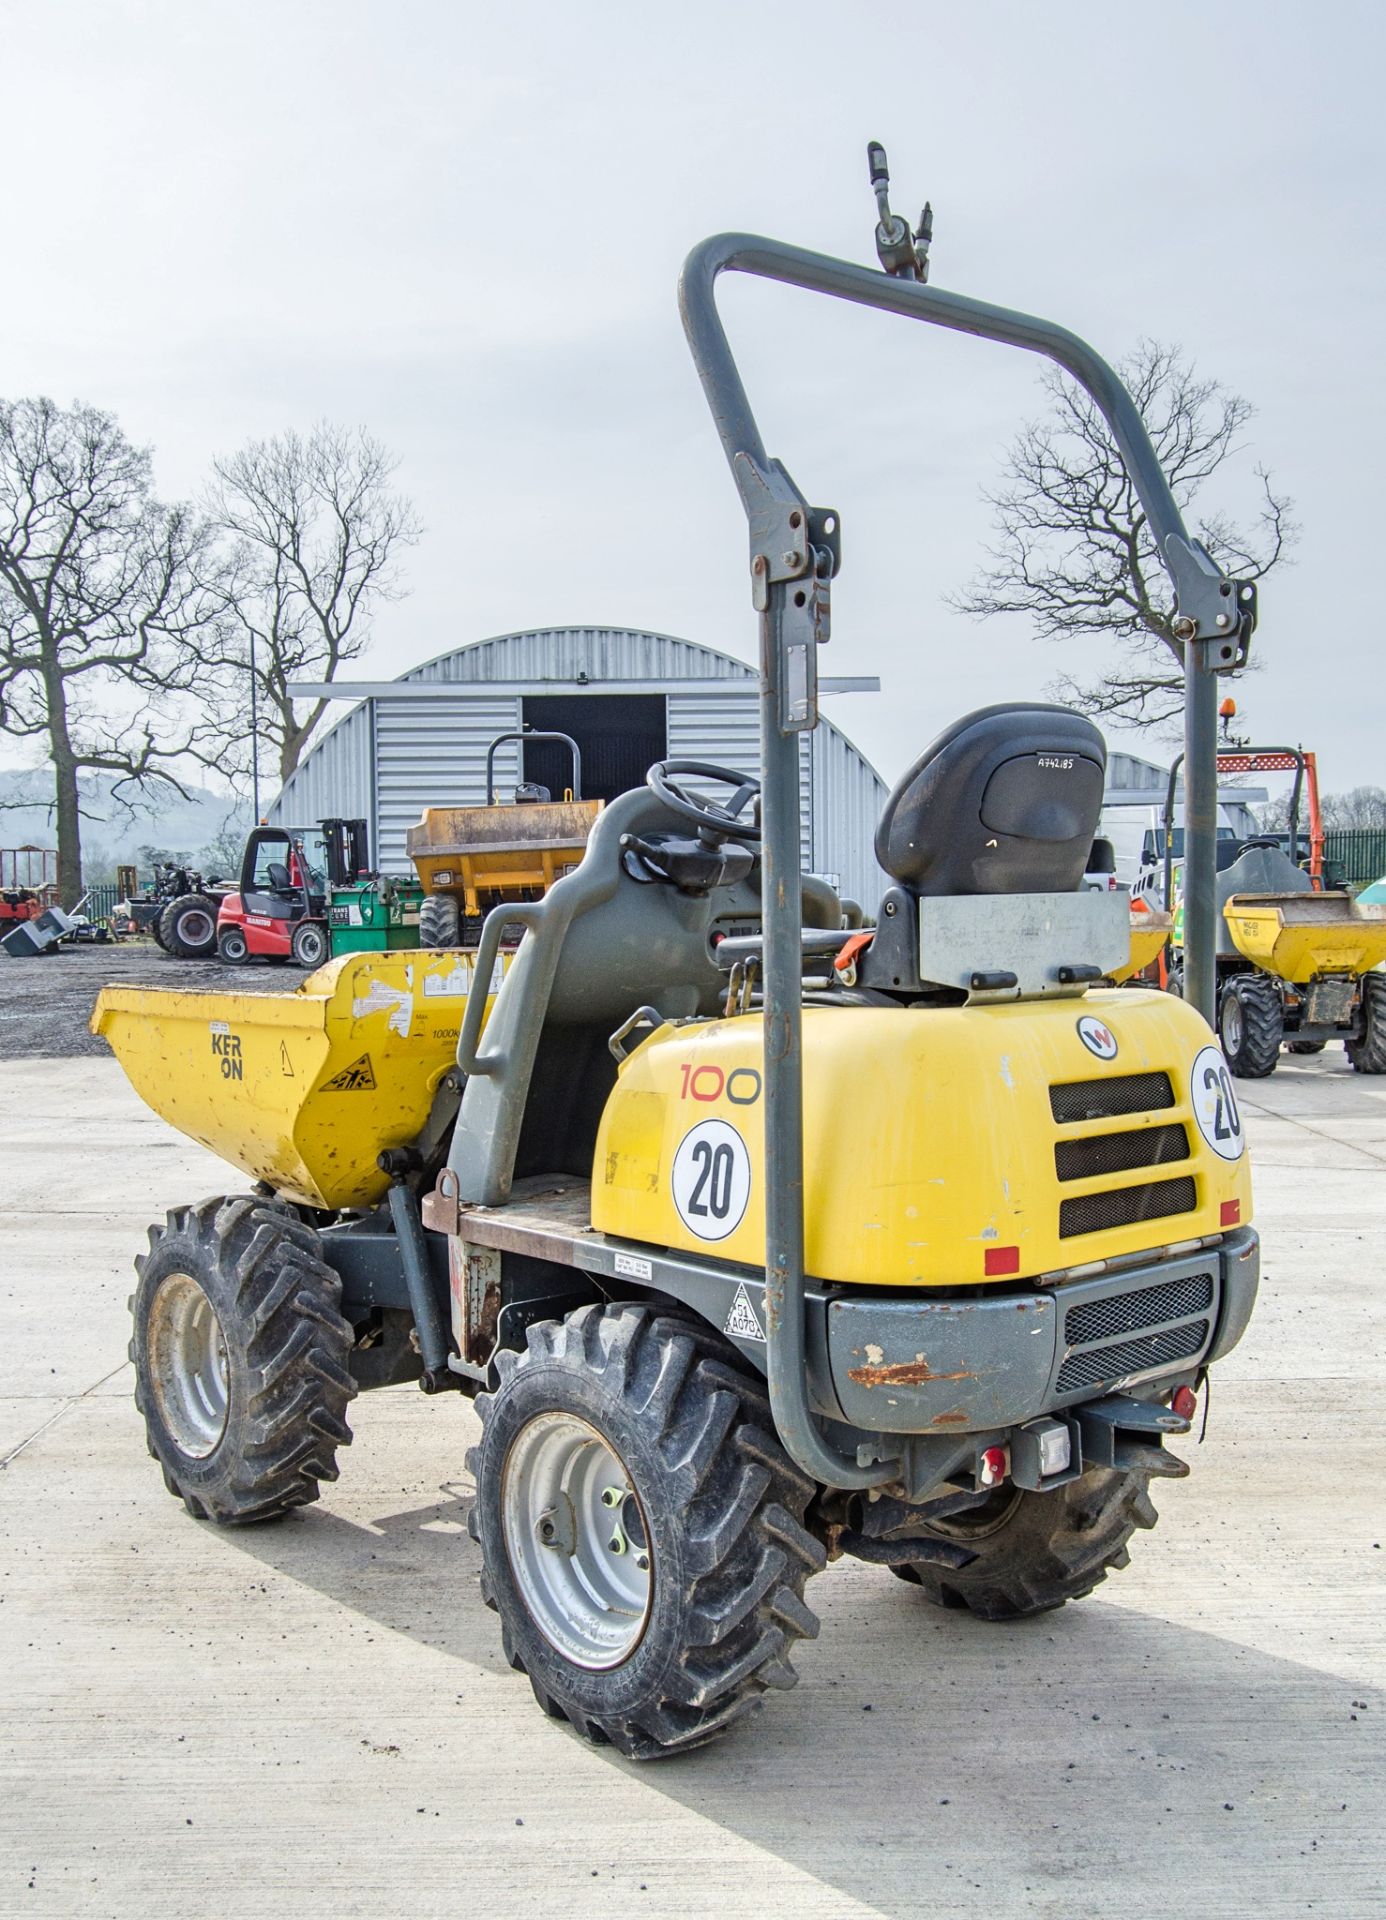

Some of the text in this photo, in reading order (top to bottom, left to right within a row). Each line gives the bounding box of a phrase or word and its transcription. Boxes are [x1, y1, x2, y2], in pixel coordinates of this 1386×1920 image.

[212, 1033, 242, 1057] KER
[432, 1028, 461, 1039] 1000k
[221, 1057, 242, 1080] ON
[681, 1064, 762, 1105] 100
[1203, 1066, 1241, 1141] 20
[688, 1140, 734, 1219] 20
